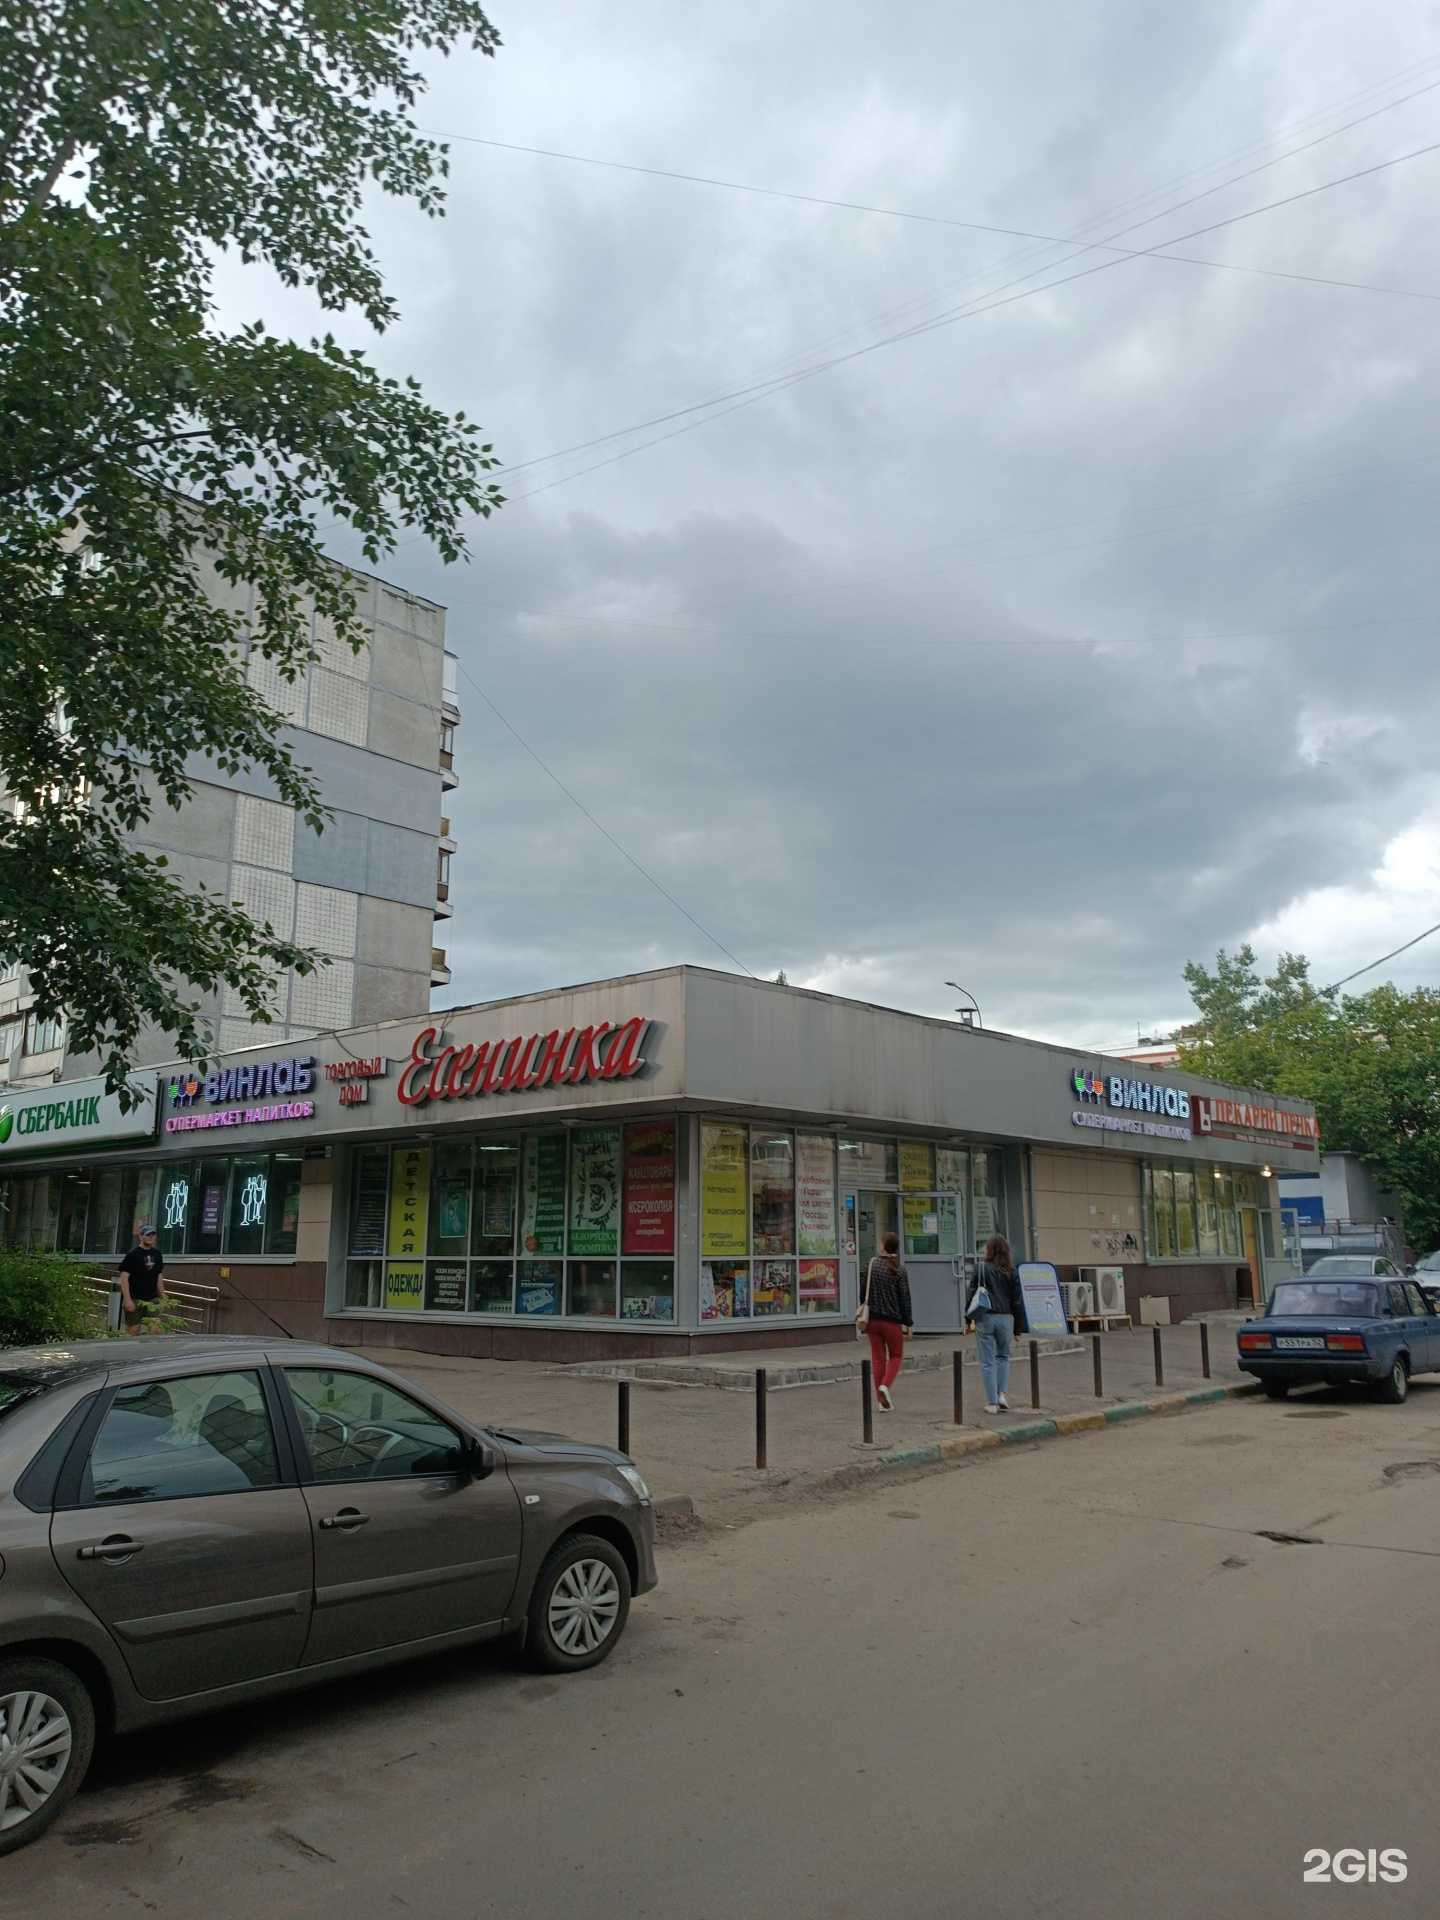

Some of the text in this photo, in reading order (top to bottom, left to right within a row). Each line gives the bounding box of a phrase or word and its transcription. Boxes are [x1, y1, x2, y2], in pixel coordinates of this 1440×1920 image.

[324, 1056, 384, 1081] ТОРГОВЫЙ
[397, 1017, 648, 1104] Есенинка
[338, 1084, 364, 1105] ДОМ
[17, 1095, 101, 1134] СБЕРБАНК
[166, 1101, 314, 1132] СУПЕРМАРКЕТ НАПИТКОВ
[402, 1152, 420, 1253] ДЕТСКАЯ
